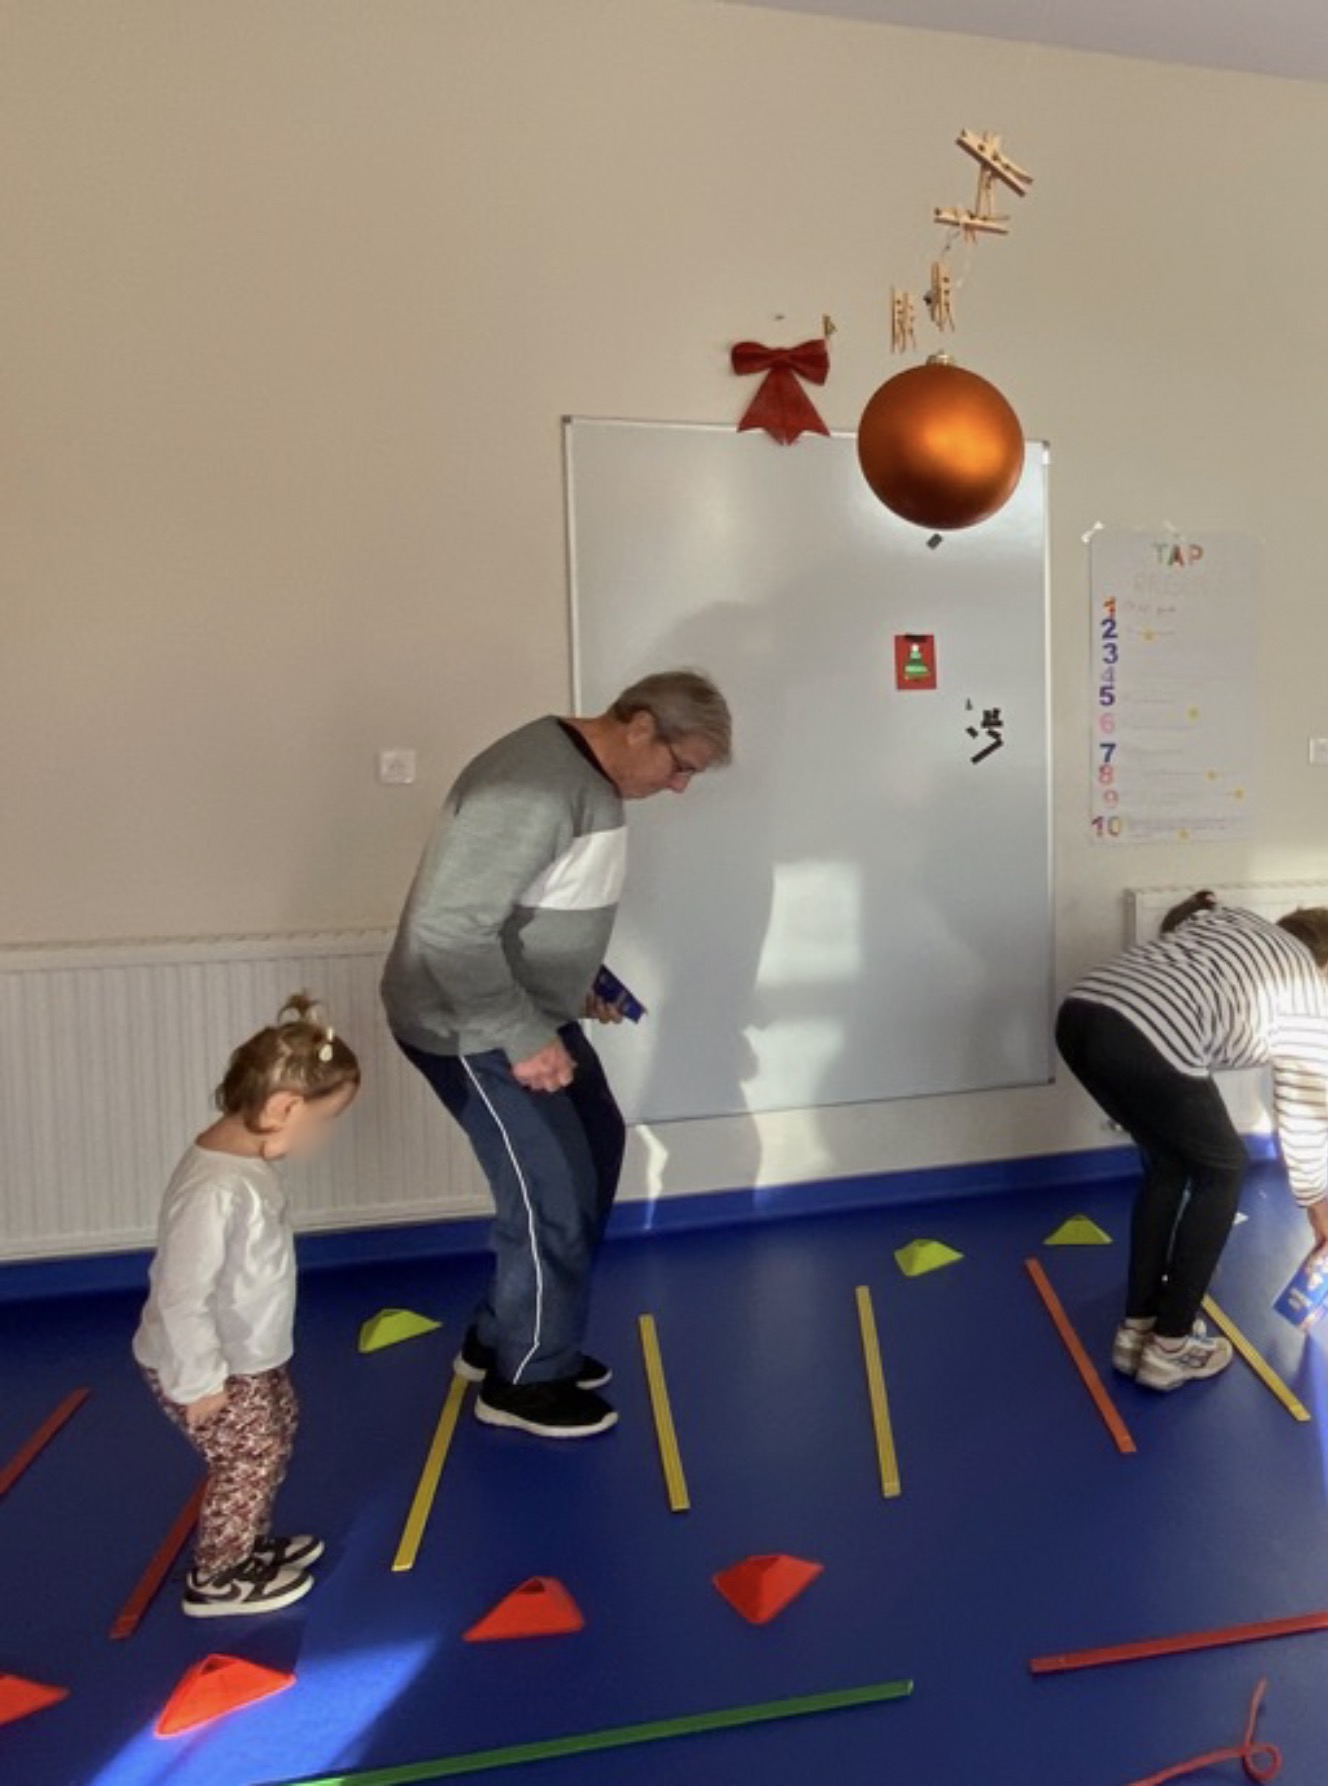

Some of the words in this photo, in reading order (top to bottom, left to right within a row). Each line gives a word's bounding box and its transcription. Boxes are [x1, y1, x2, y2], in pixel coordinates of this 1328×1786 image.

[1153, 542, 1205, 568] TAP
[1103, 596, 1117, 619] 1
[1101, 618, 1119, 640] 2
[1102, 643, 1119, 664] 3
[1101, 666, 1115, 685] 4
[1099, 686, 1116, 706] 5
[1099, 712, 1115, 734] 6
[1099, 743, 1117, 763] 7
[1099, 764, 1114, 785] 8
[1104, 790, 1119, 809] 9
[1091, 816, 1122, 838] 10
